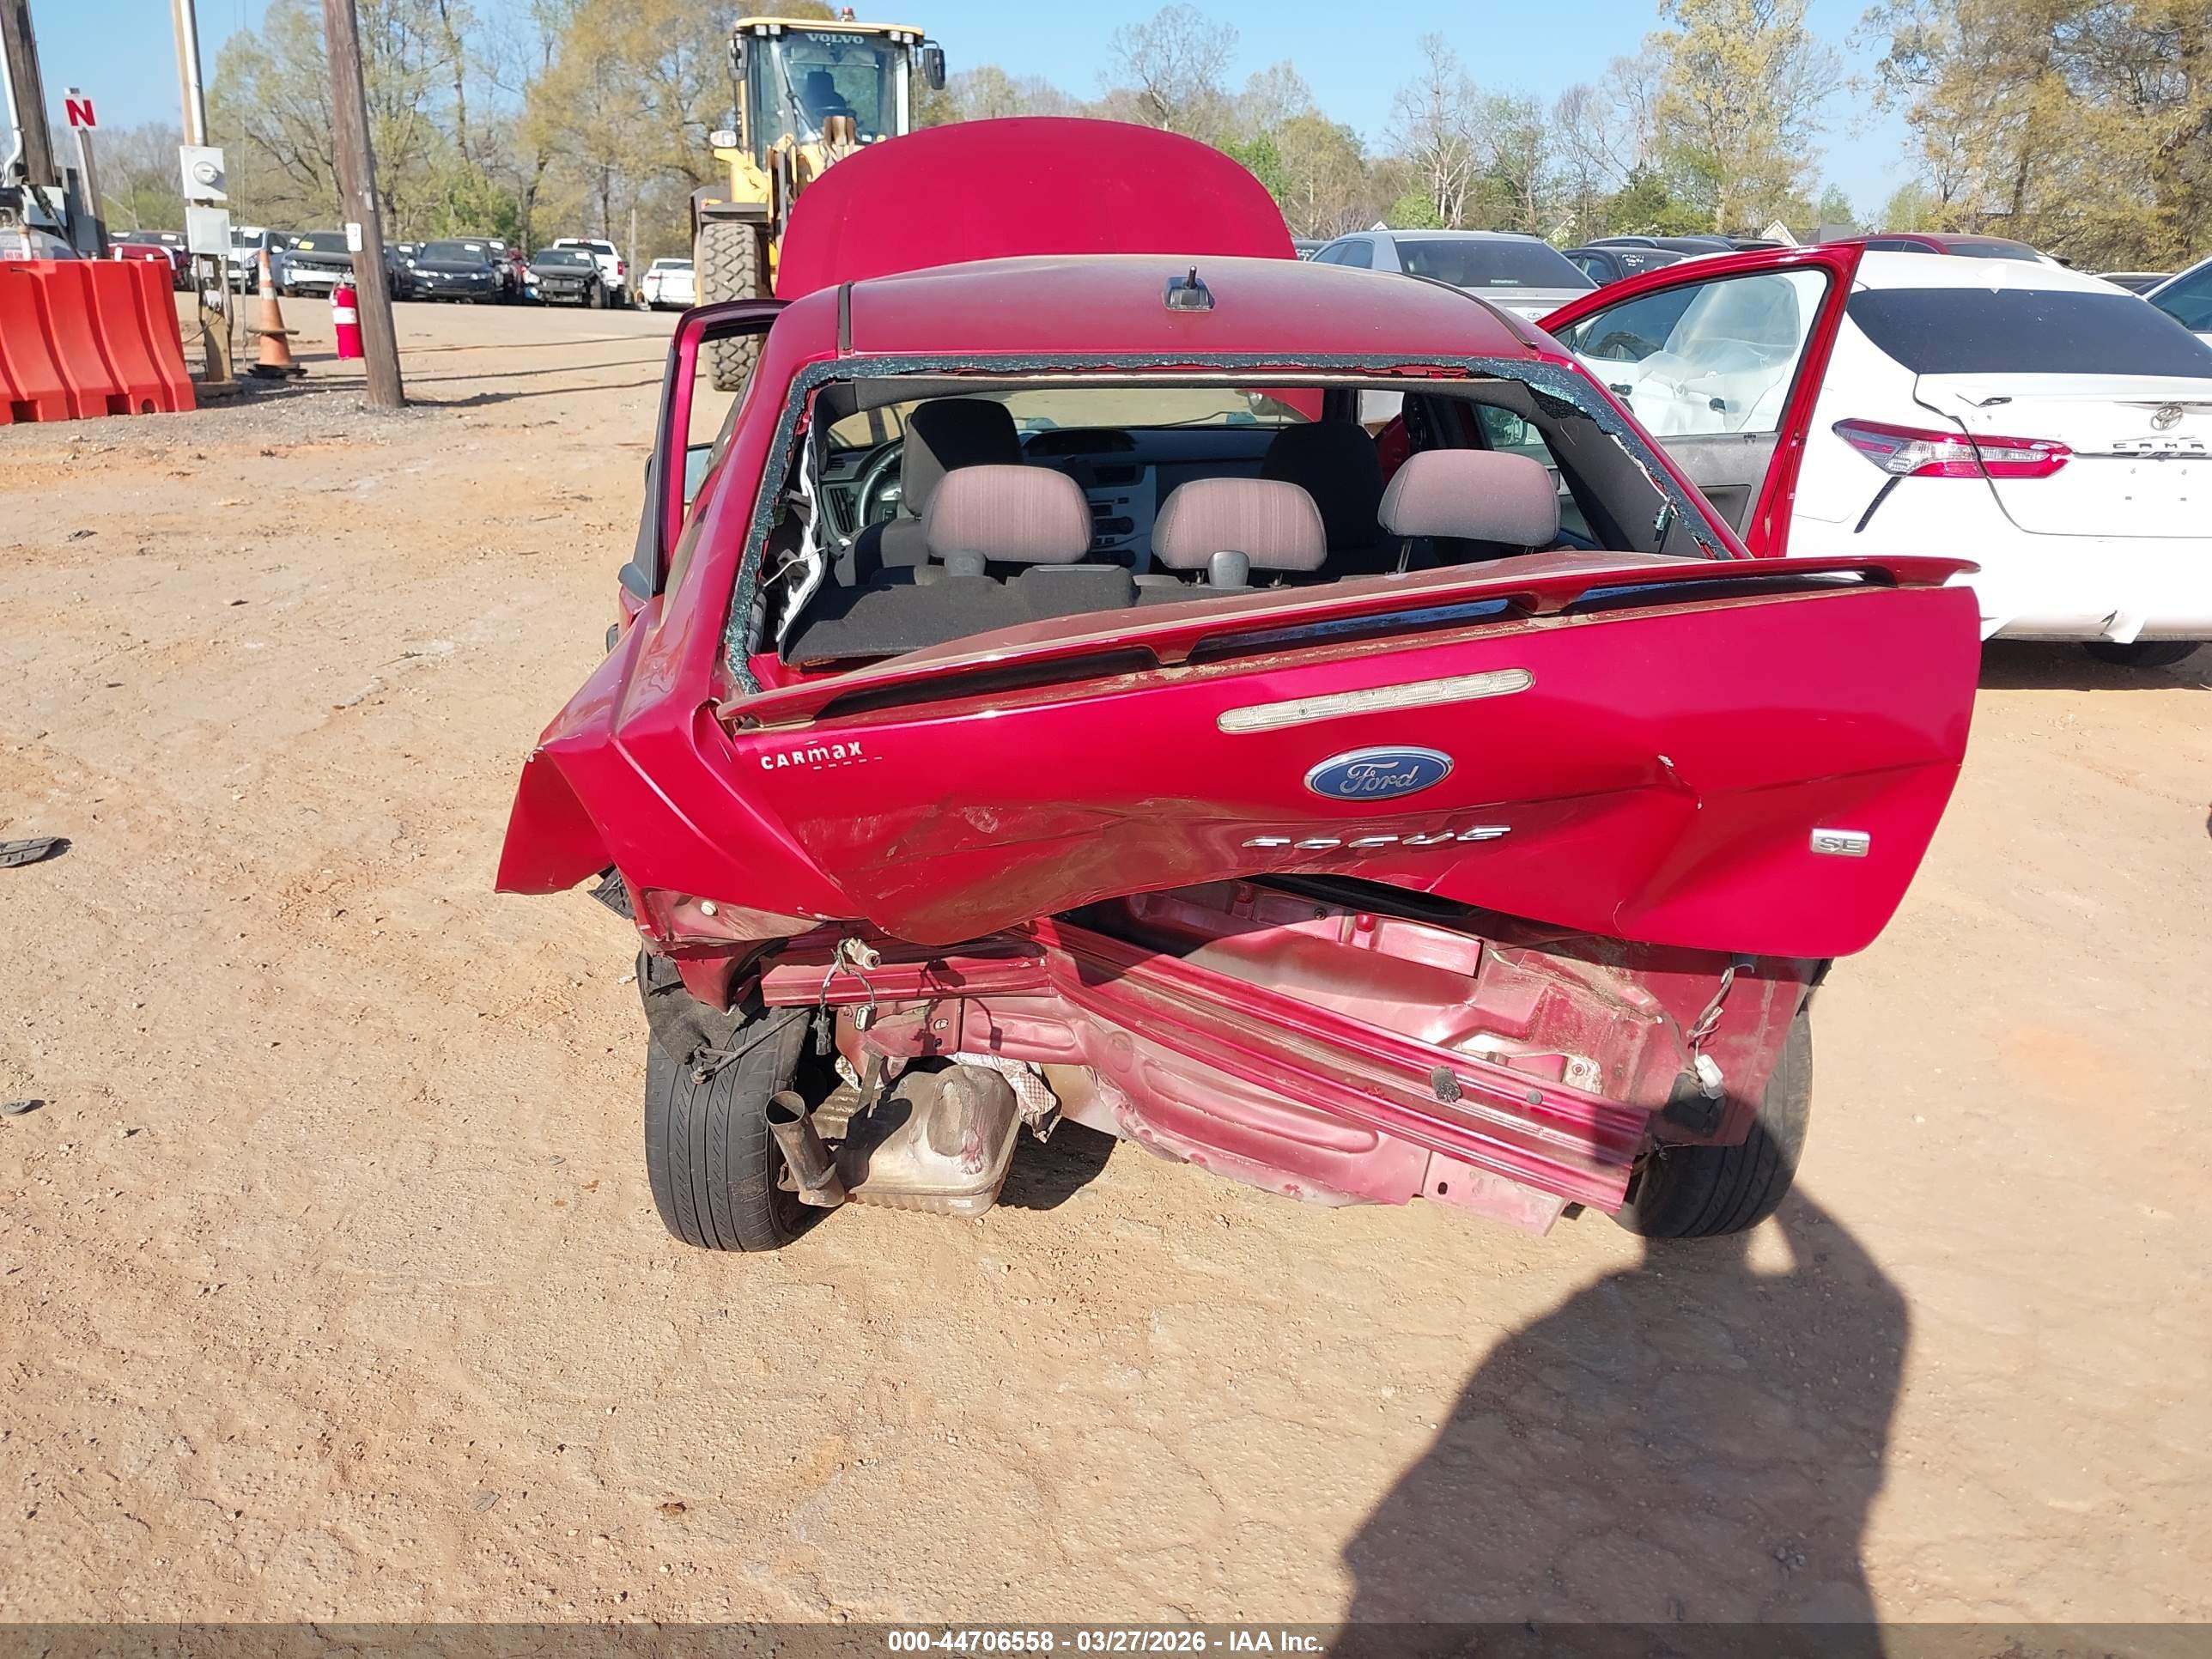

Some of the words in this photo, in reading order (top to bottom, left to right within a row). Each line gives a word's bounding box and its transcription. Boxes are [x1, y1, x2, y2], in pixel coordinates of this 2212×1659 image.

[805, 33, 865, 45] VOLVO
[65, 99, 96, 126] N
[1340, 761, 1419, 794] Ford
[1242, 824, 1511, 849] FOCUS
[1820, 836, 1863, 854] SE
